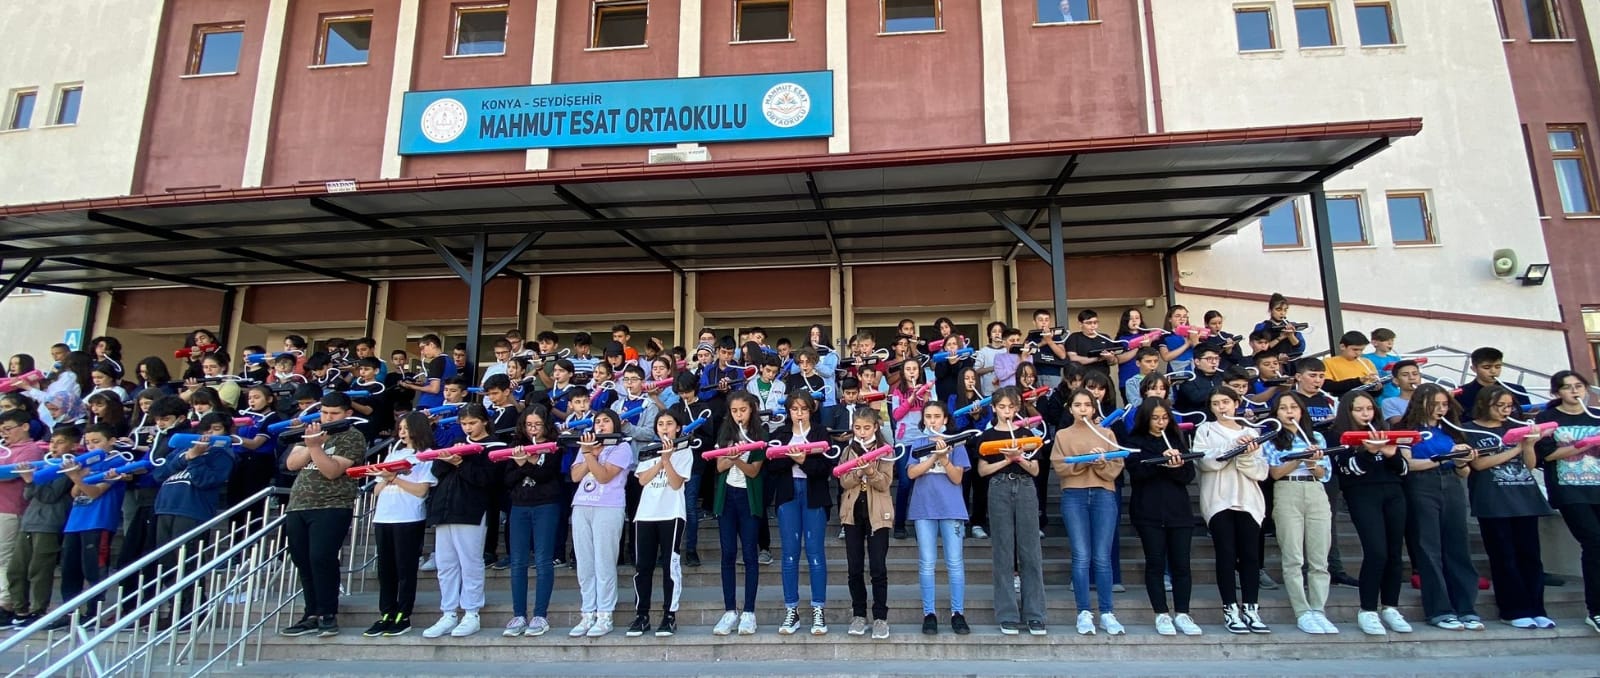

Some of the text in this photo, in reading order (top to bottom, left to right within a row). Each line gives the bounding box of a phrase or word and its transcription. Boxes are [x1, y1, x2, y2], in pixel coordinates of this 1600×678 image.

[481, 99, 522, 110] KONYA
[532, 92, 602, 108] SEYDİŞEHİR
[764, 84, 808, 105] MAHMUT ESAT
[479, 103, 747, 139] MAHMUT ESAT ORTAOKULU
[766, 108, 807, 126] ORTAOKULU
[66, 332, 77, 346] A
